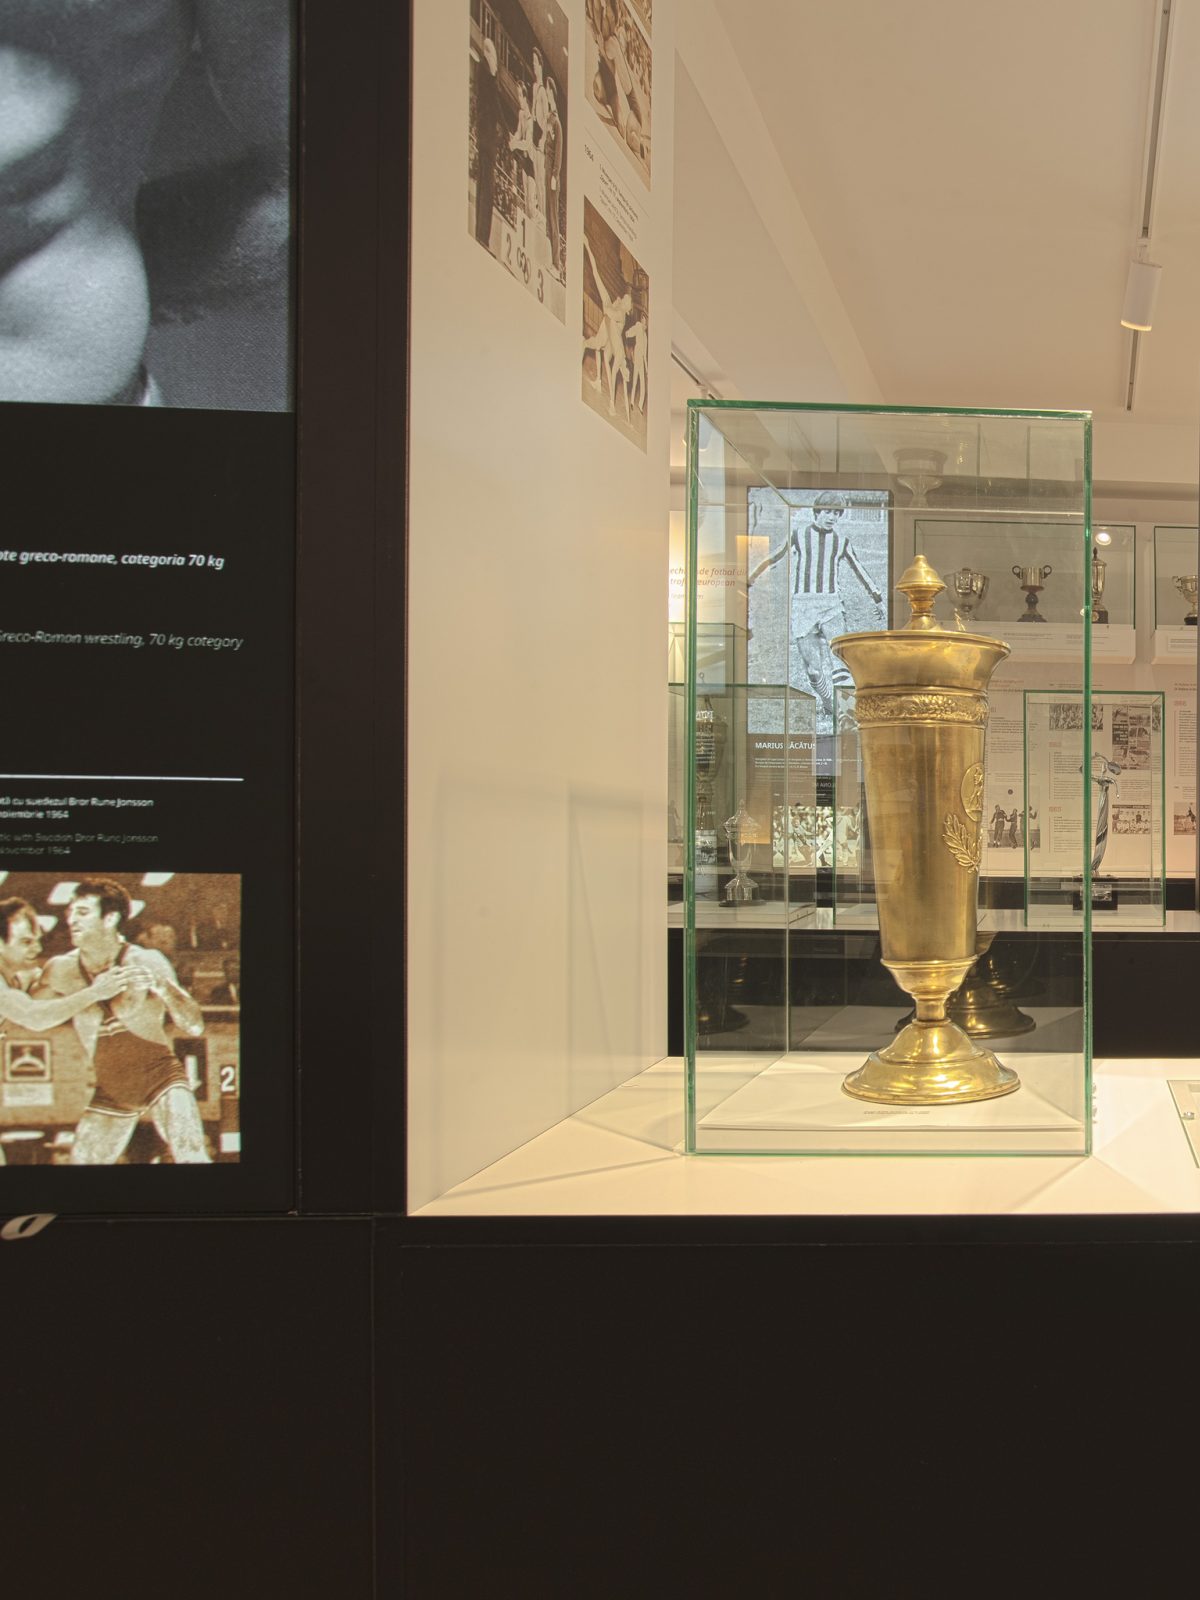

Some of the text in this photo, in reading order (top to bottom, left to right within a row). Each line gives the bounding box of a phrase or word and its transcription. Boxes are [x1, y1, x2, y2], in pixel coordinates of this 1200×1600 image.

[19, 551, 118, 565] greco-romane,
[121, 554, 185, 568] categoria
[188, 554, 205, 566] 70
[207, 555, 225, 570] kg
[84, 632, 145, 648] wrestling,
[149, 633, 166, 646] 70
[168, 634, 184, 649] kg
[187, 636, 244, 651] category
[755, 742, 784, 750] MARIUS
[68, 797, 89, 806] Bror
[91, 798, 116, 807] Rune
[116, 798, 154, 808] Jonsson
[221, 1066, 235, 1092] 2
